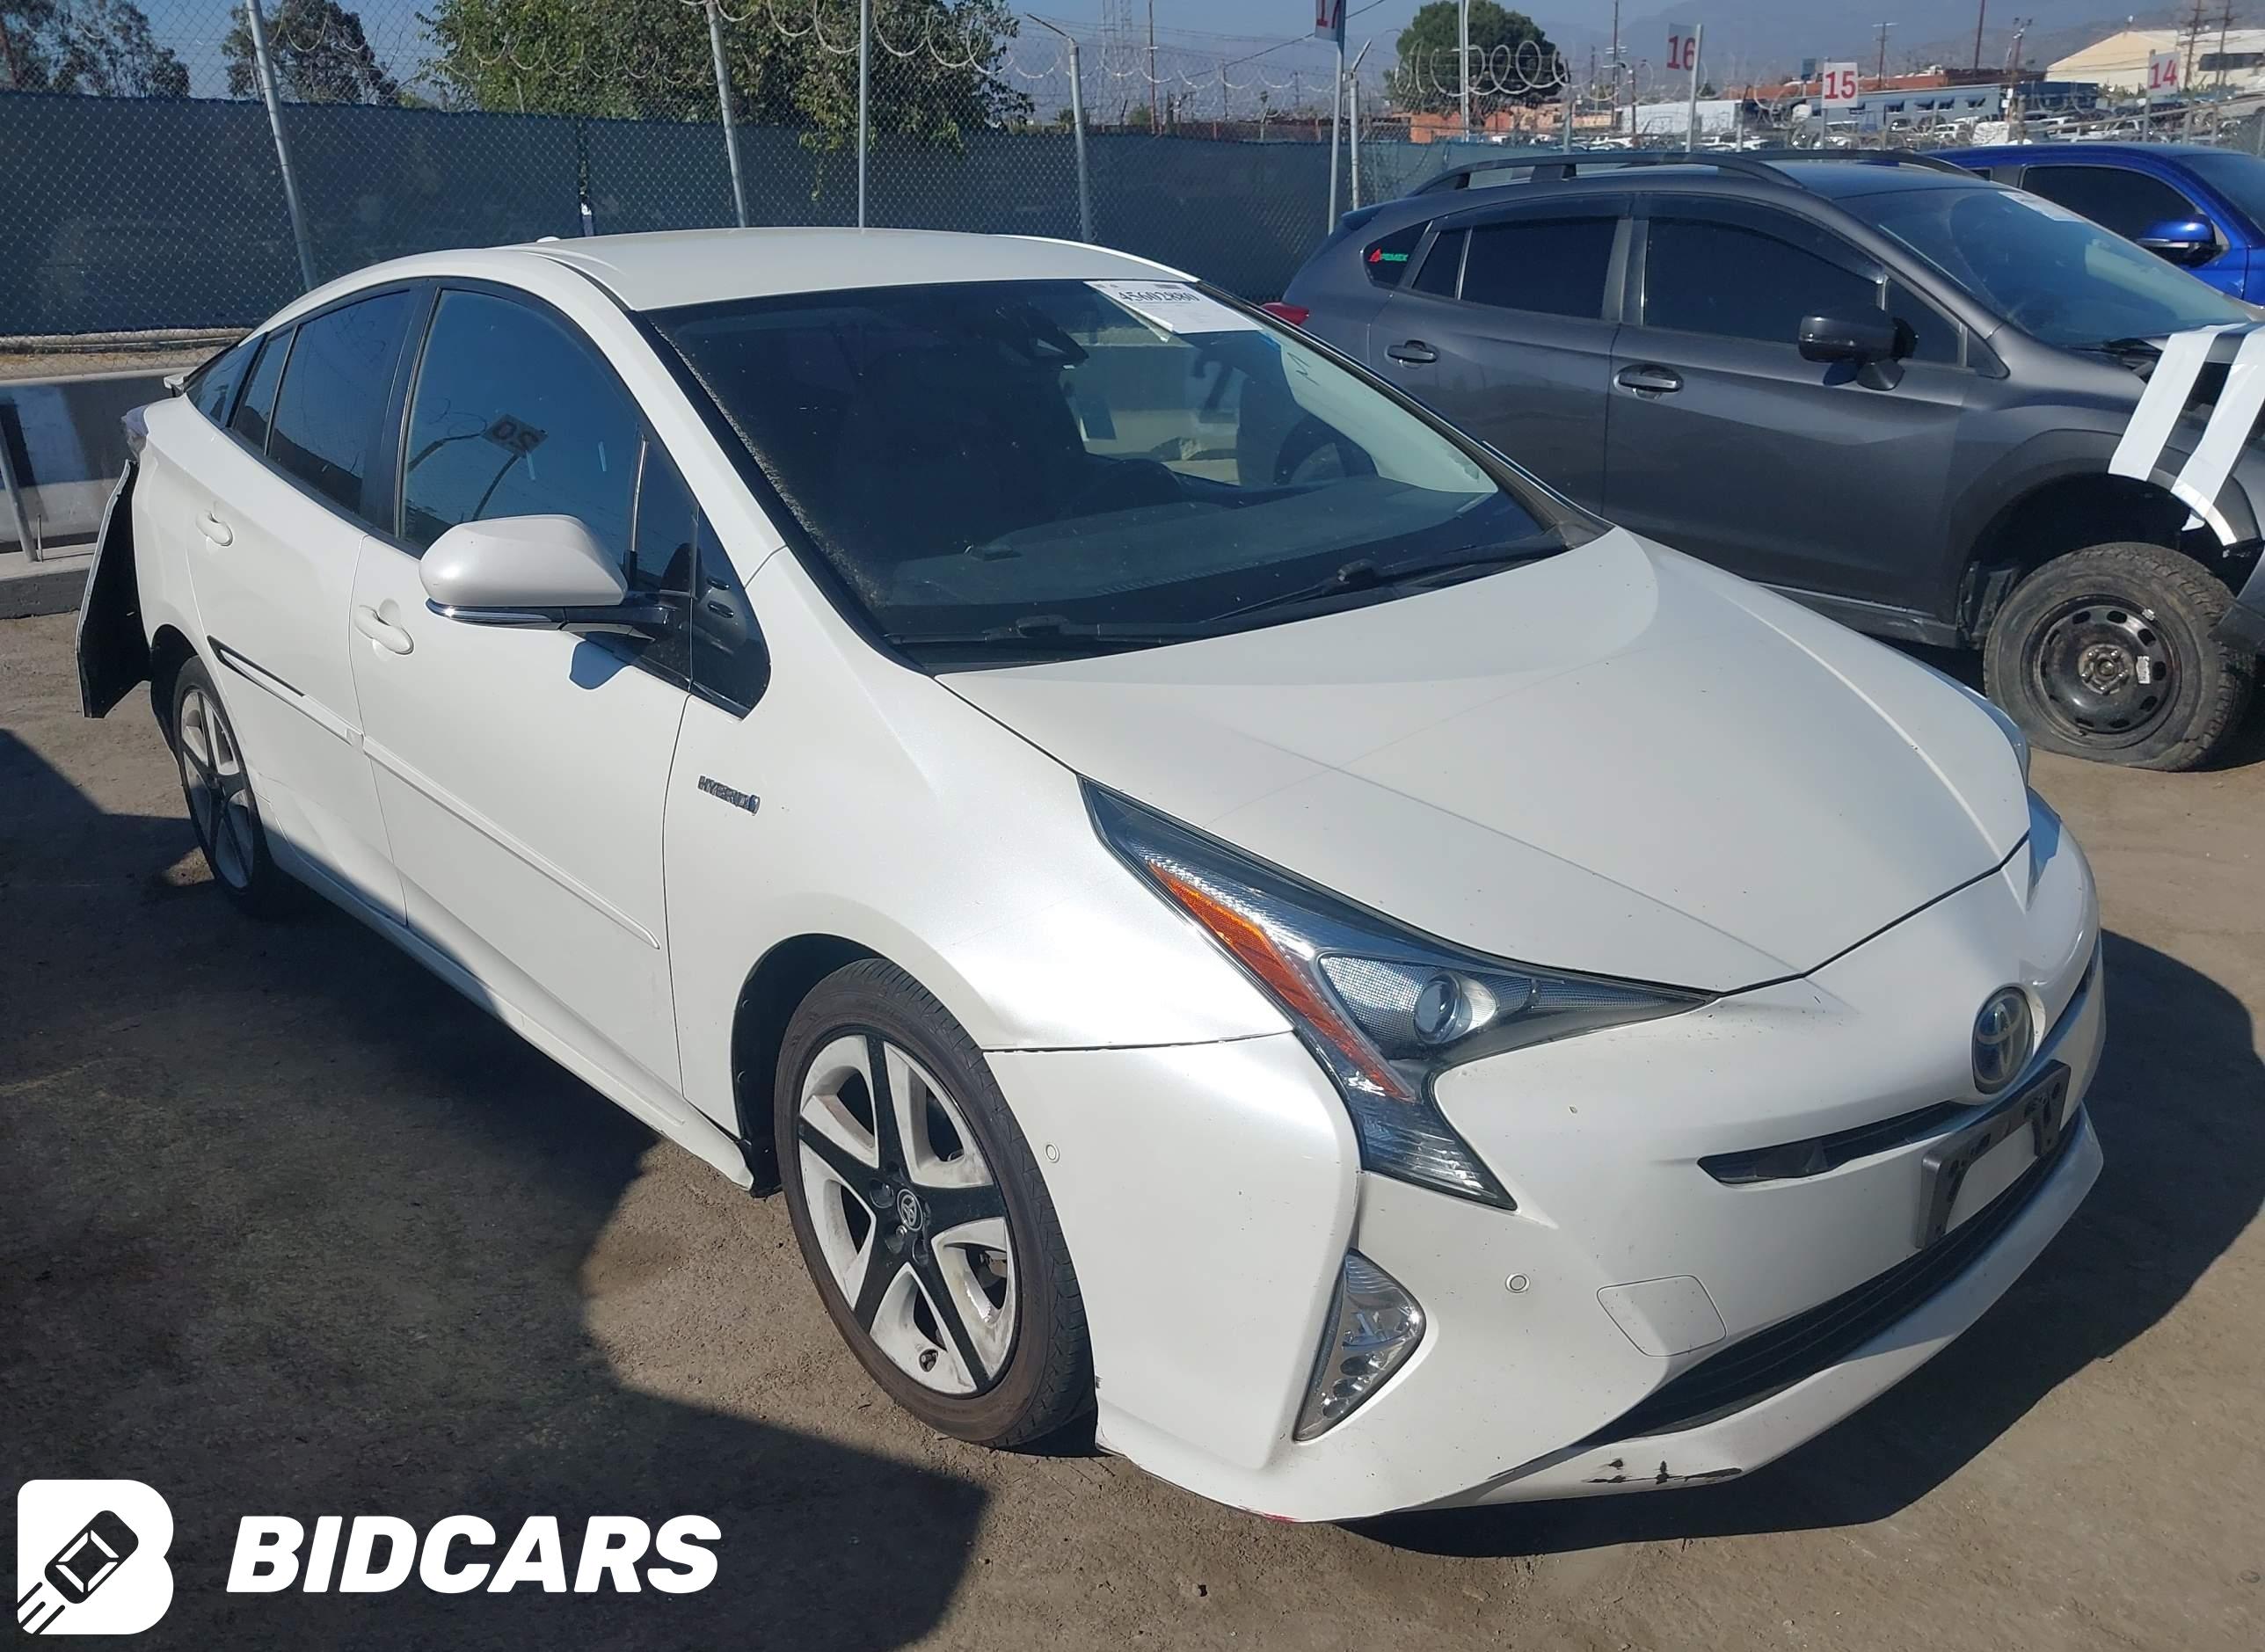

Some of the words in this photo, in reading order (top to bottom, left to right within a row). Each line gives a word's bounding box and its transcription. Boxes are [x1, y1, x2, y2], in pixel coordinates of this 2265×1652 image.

[1667, 35, 1695, 70] 16
[1824, 70, 1856, 99] 15
[2150, 60, 2177, 89] 14
